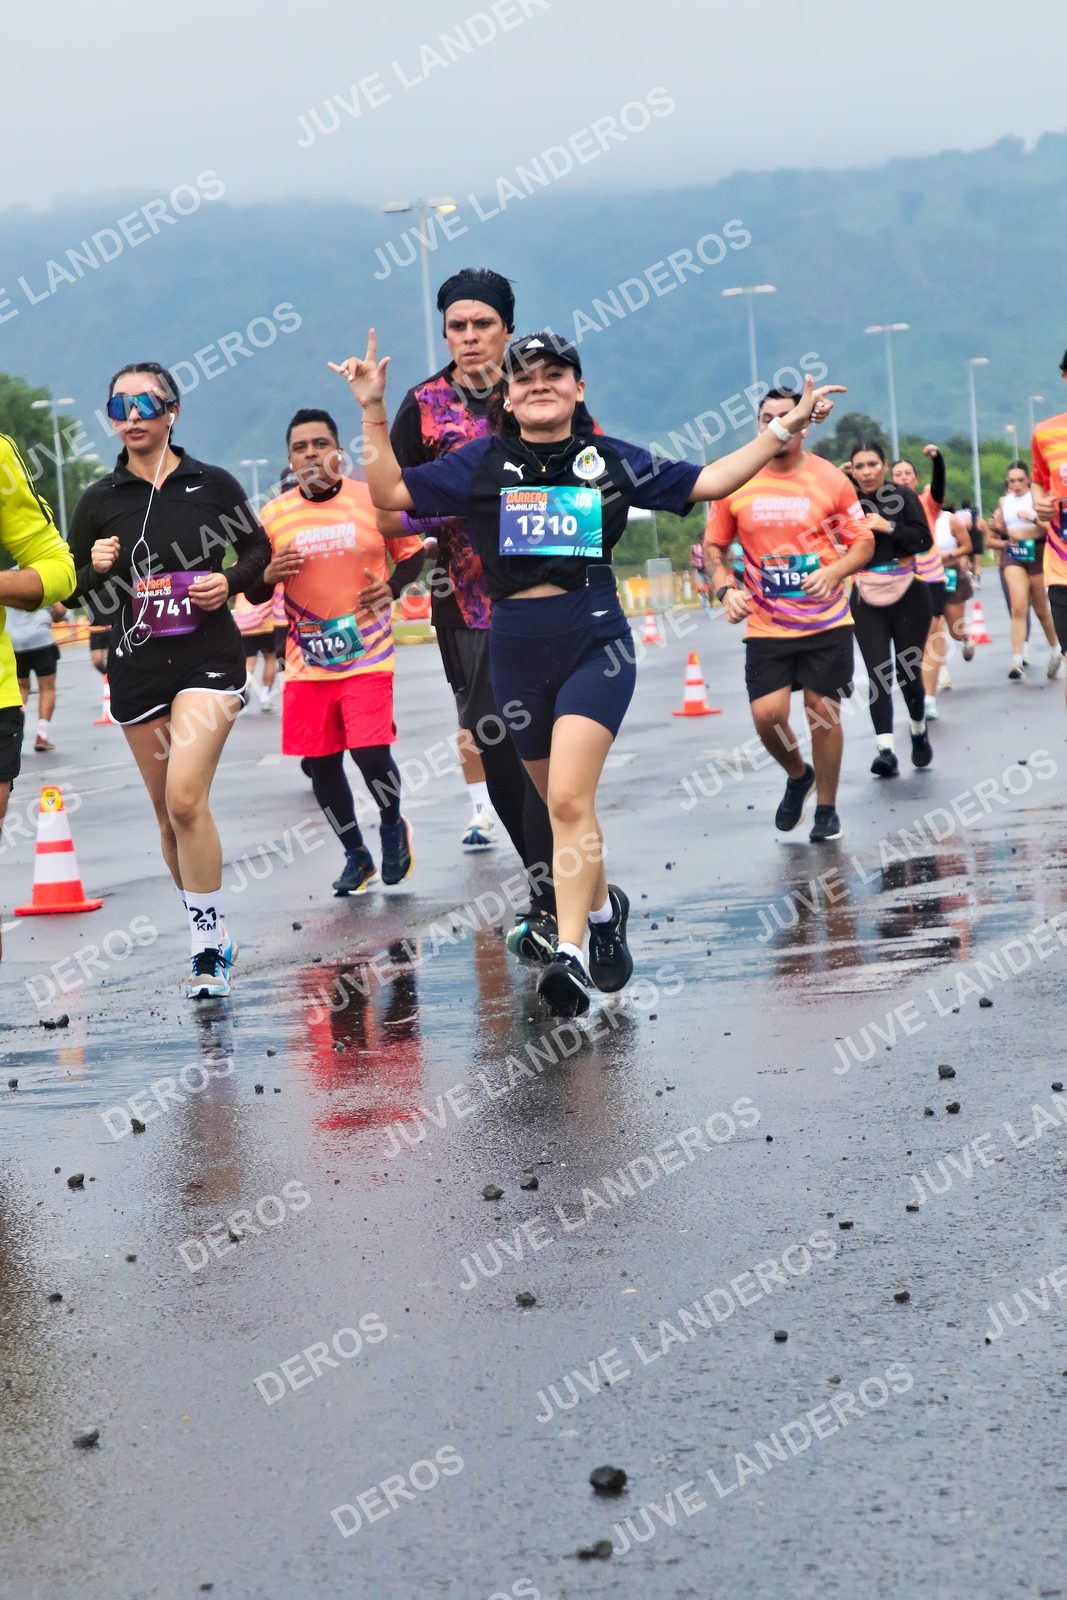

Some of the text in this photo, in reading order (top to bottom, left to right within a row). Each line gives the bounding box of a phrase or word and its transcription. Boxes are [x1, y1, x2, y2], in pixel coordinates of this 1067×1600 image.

[506, 492, 547, 504] CARRERA
[575, 492, 592, 507] 10K
[517, 515, 577, 536] 1210
[153, 597, 191, 618] 741
[308, 636, 345, 653] 1174
[189, 907, 216, 922] 21
[197, 922, 216, 931] KM
